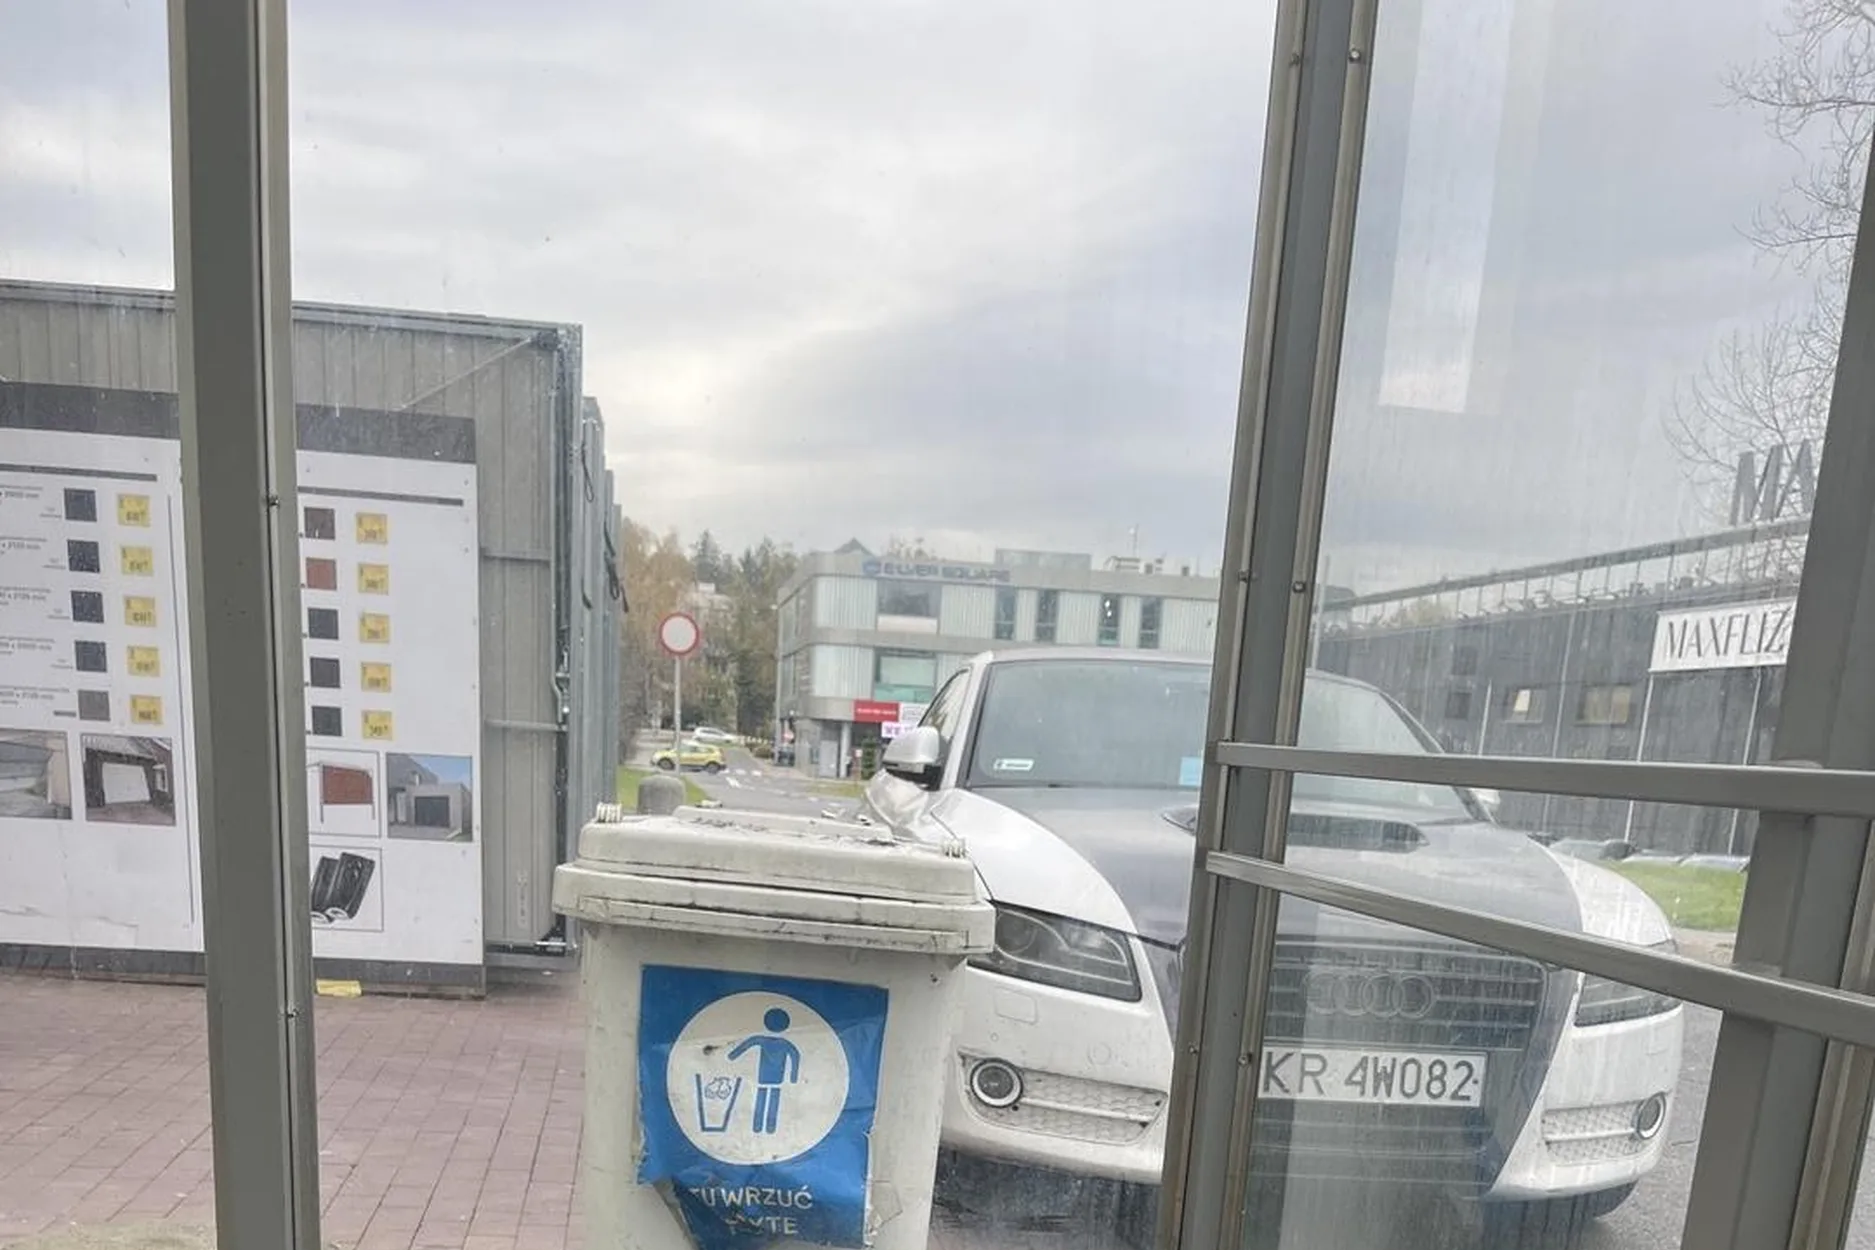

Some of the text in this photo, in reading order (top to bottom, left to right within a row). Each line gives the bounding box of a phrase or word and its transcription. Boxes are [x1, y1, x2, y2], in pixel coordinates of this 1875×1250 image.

[1665, 605, 1792, 659] MAXFLIZ
[1262, 1051, 1474, 1101] KR 4W082
[721, 1184, 813, 1210] WRZUĆ
